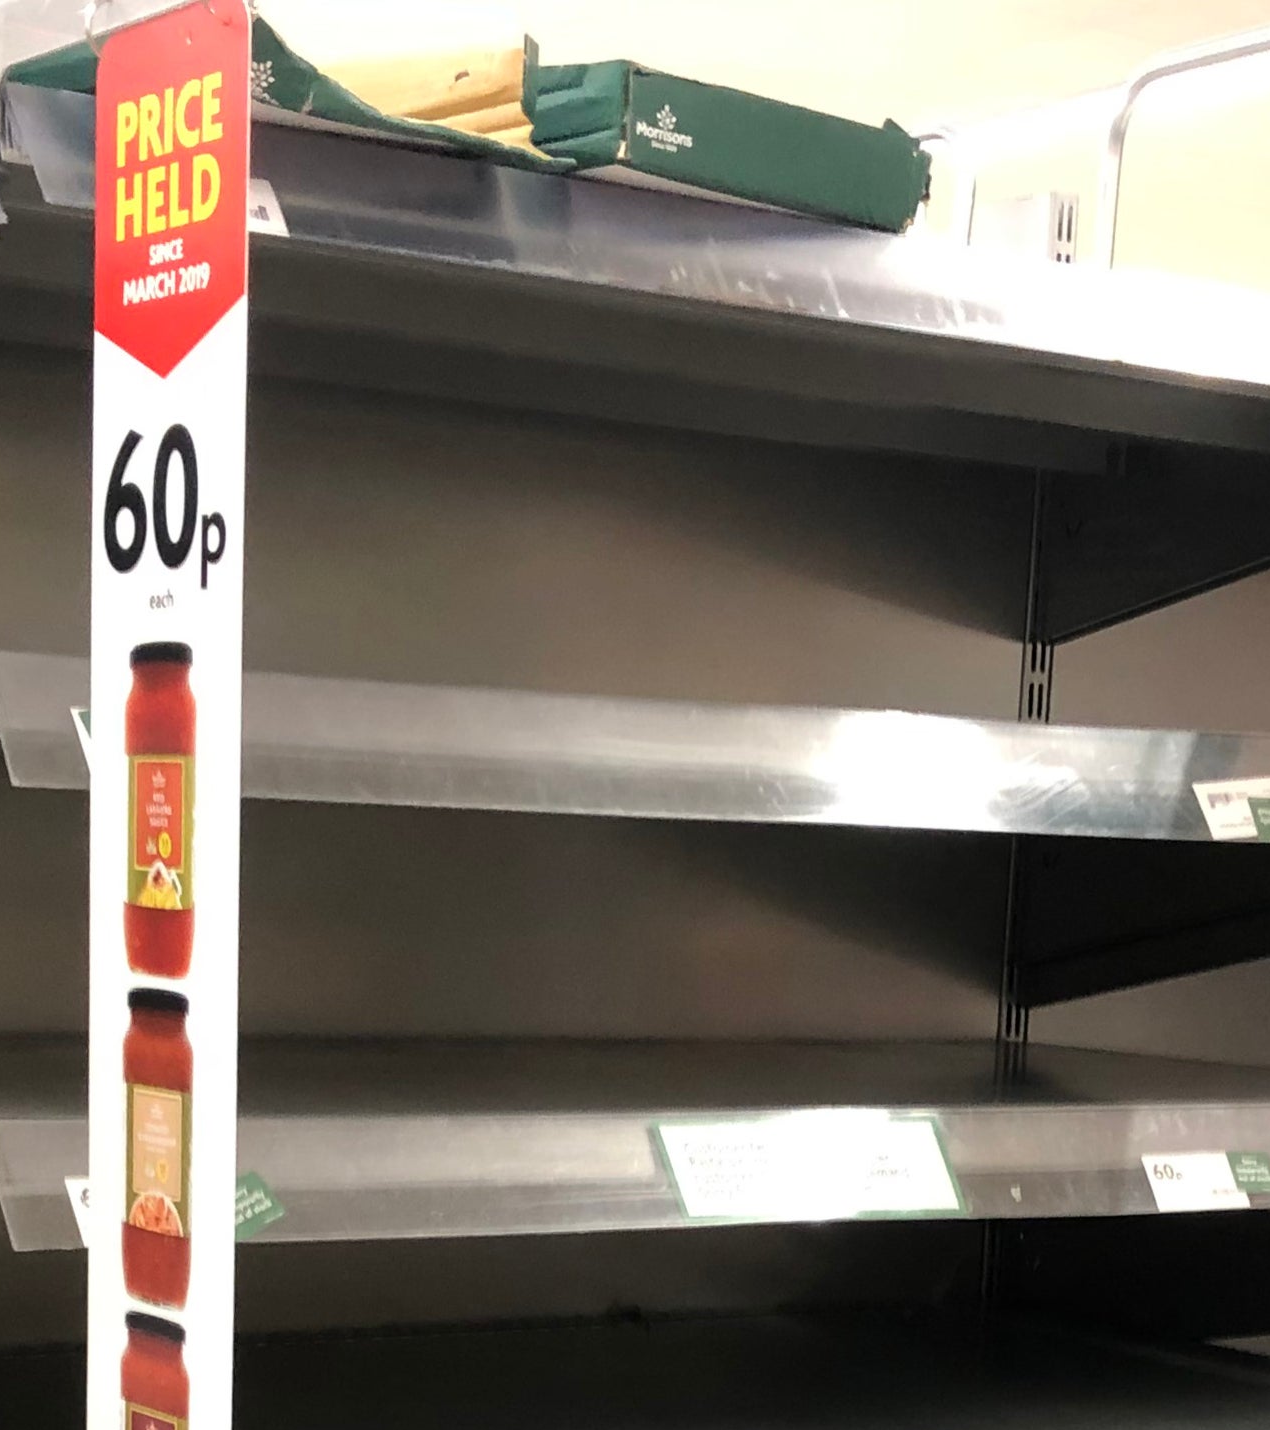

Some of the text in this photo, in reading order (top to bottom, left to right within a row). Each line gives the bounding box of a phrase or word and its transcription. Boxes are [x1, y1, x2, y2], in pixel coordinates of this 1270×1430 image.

[116, 71, 224, 168] PRICE
[635, 120, 693, 148] Morrisons
[115, 152, 221, 243] HELD
[148, 237, 184, 266] SINCE
[122, 261, 211, 306] MARCH 2019
[103, 422, 227, 590] 60p
[149, 589, 175, 610] each
